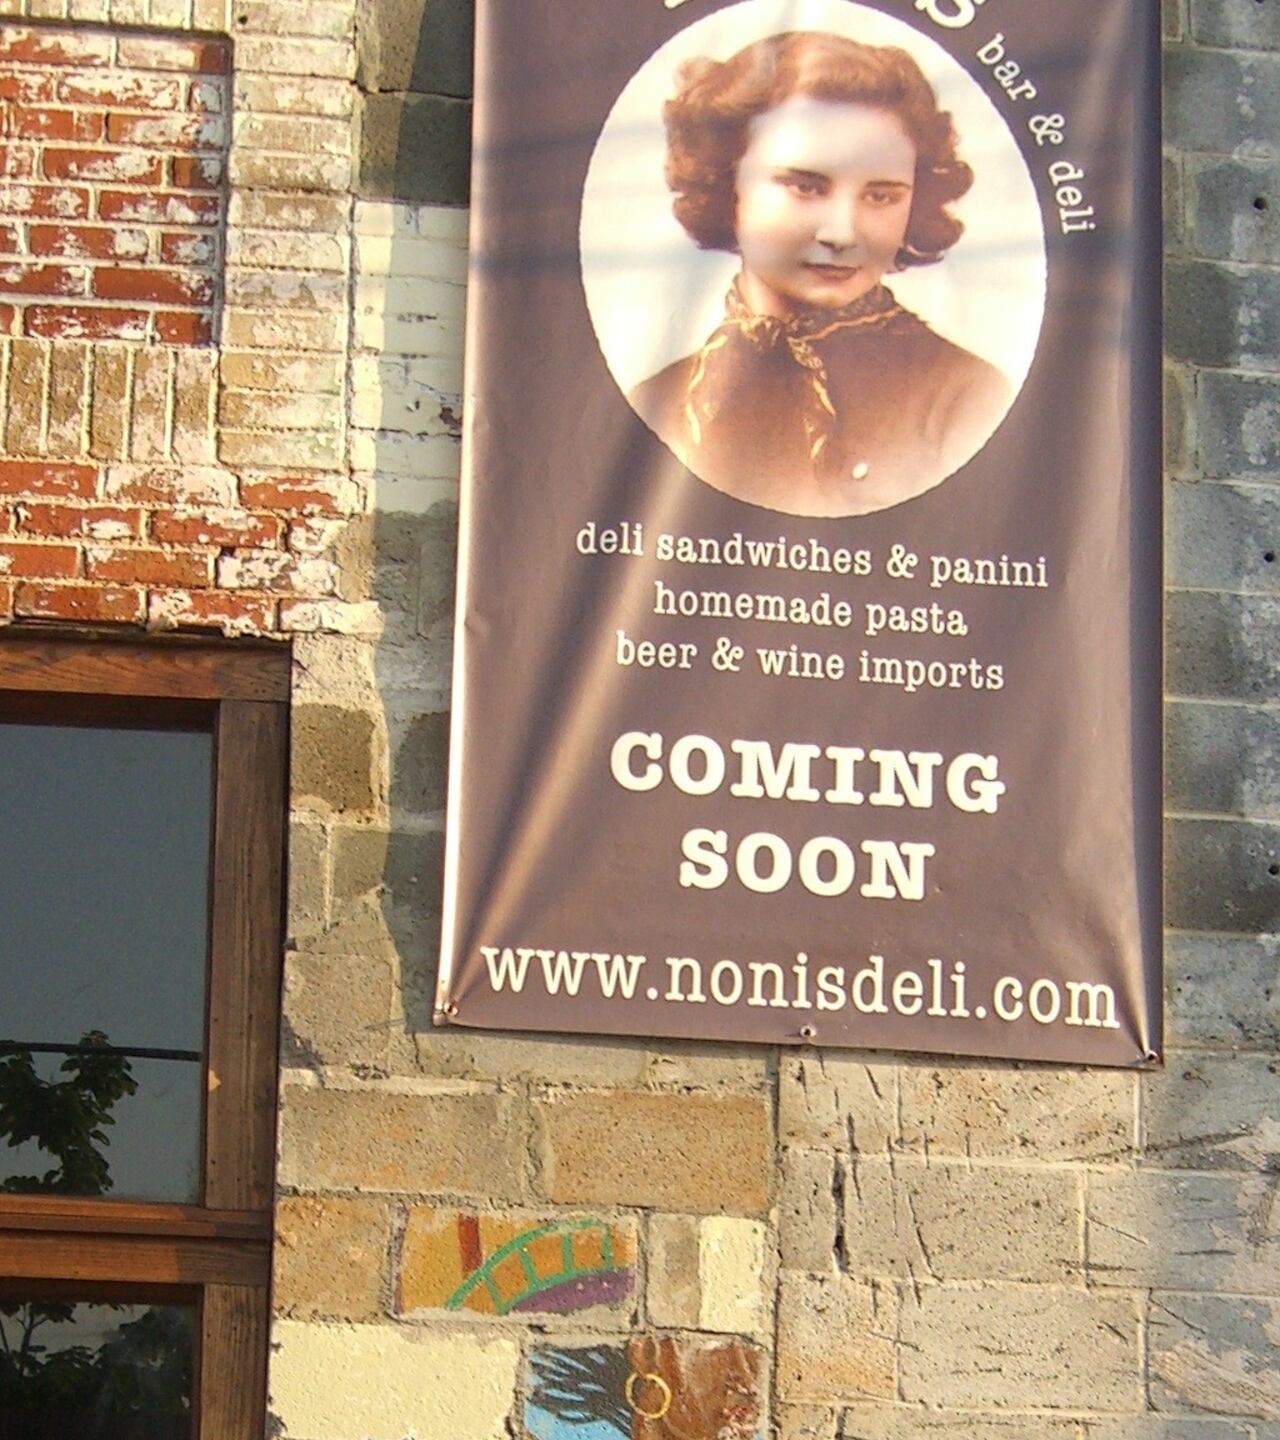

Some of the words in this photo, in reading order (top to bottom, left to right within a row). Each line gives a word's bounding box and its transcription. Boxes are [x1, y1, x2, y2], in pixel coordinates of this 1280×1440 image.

[976, 32, 1037, 101] bar
[1028, 113, 1065, 146] &
[1048, 160, 1096, 235] deli
[576, 522, 644, 556] deli
[655, 532, 872, 576] sandwiches
[886, 543, 919, 579] &
[930, 554, 1049, 588] panini
[653, 580, 853, 627] homemade
[865, 602, 969, 636] pasta
[616, 629, 698, 669] beer
[711, 636, 744, 672] &
[756, 644, 845, 681] wine
[858, 650, 1005, 693] imports
[609, 731, 1006, 814] COMING
[678, 828, 935, 901] SOON
[479, 945, 1120, 1030] www.nonisdeli.com
